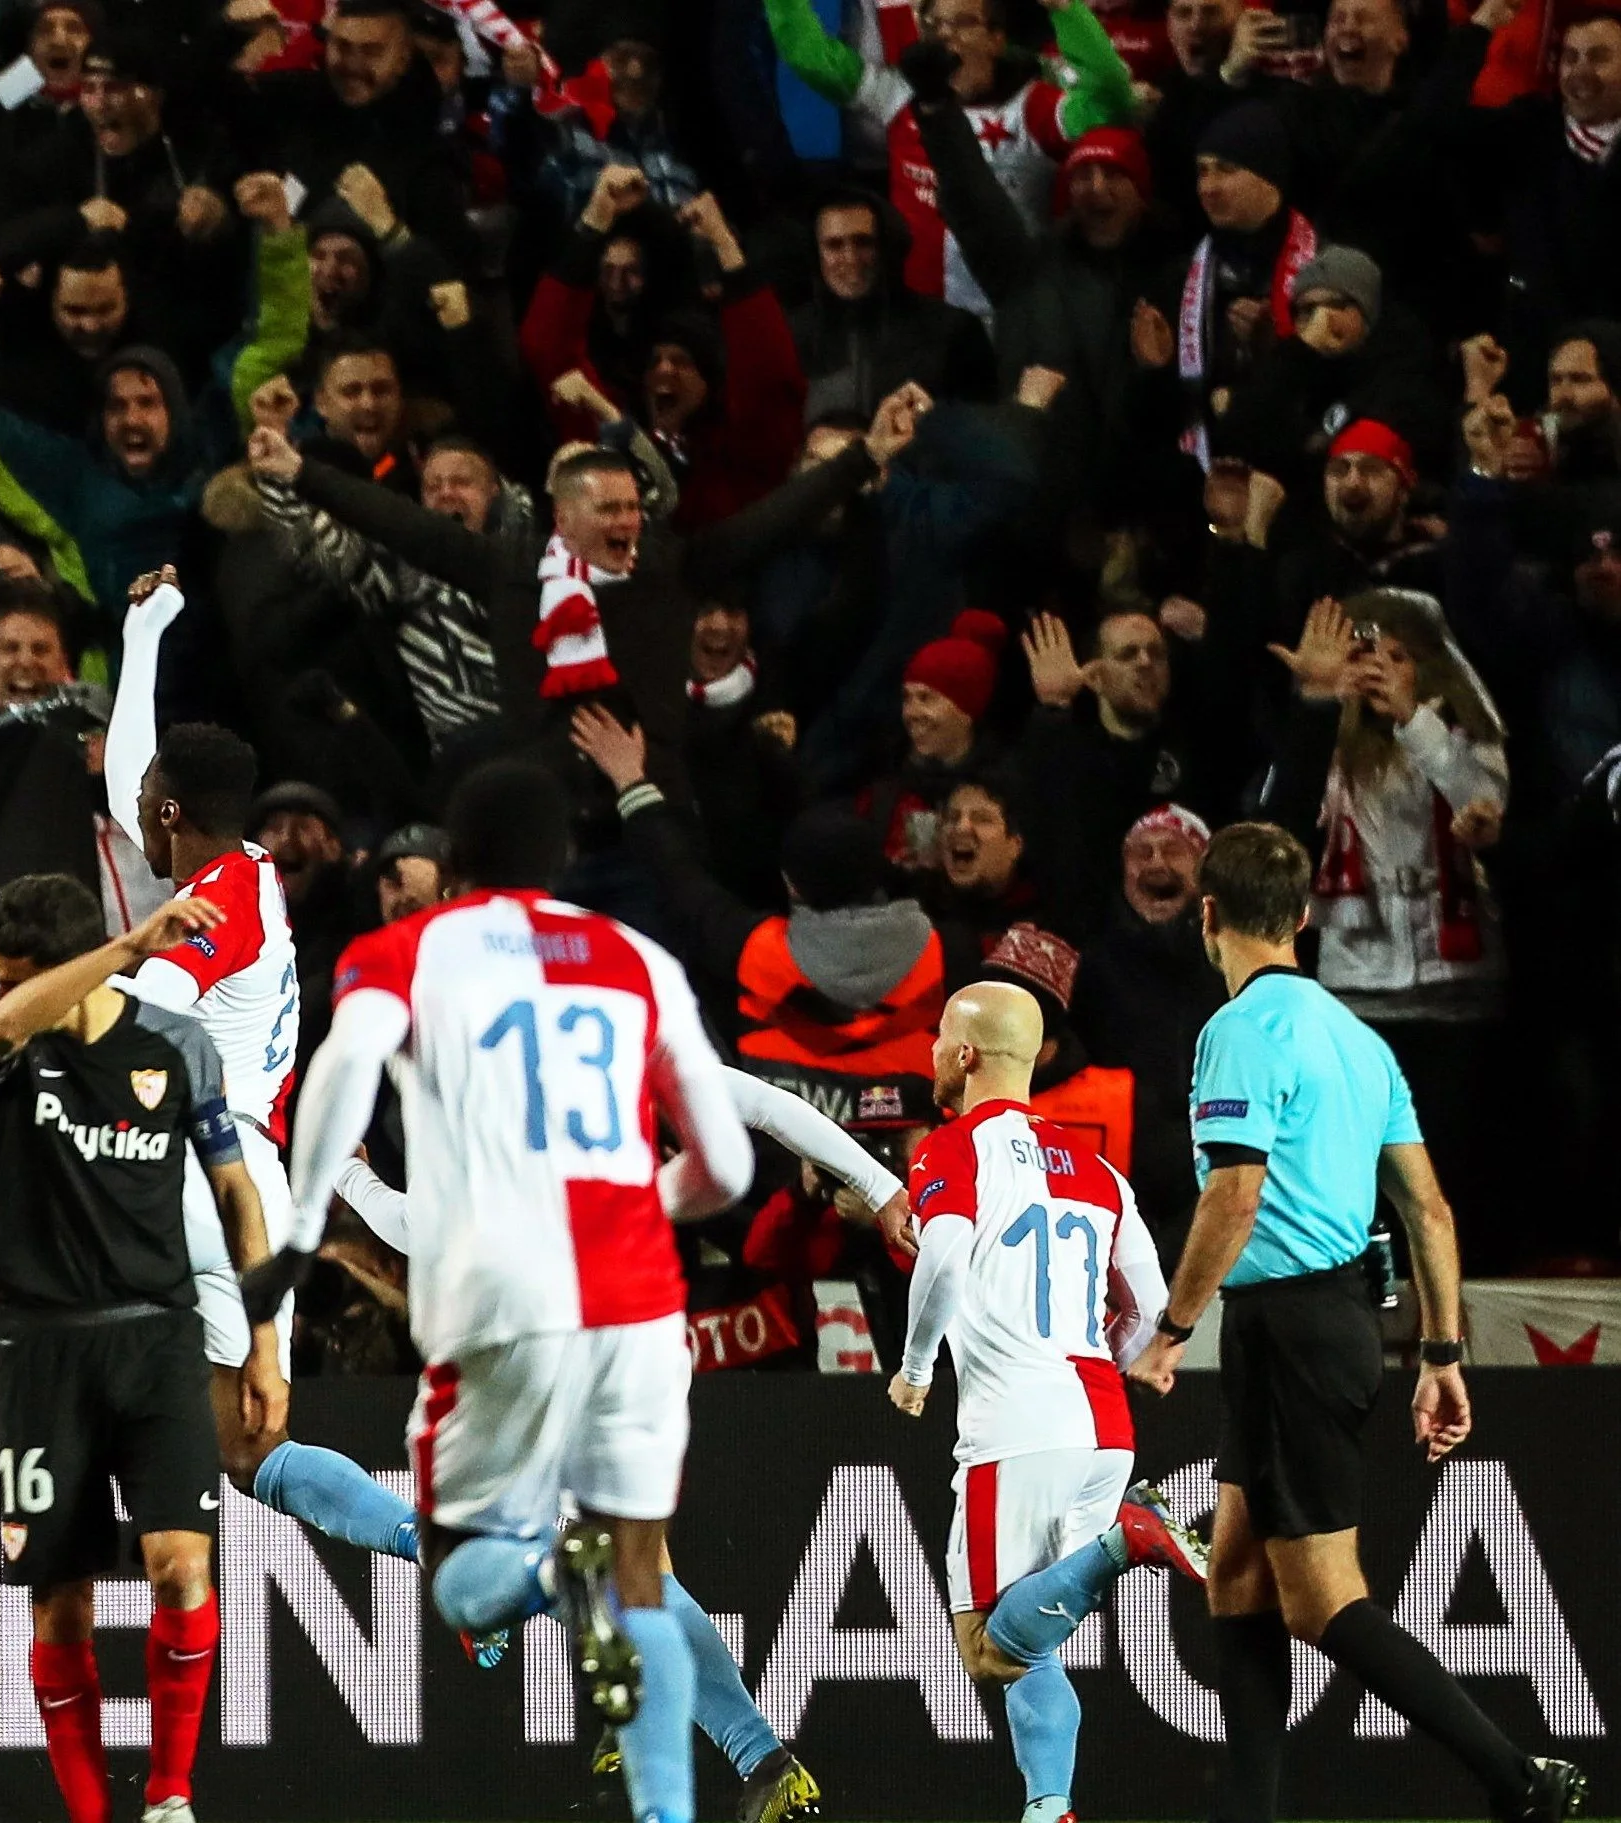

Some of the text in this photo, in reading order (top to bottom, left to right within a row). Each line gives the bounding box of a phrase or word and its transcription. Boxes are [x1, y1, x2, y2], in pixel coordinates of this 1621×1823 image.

[479, 1000, 623, 1152] 13
[1011, 1138, 1076, 1177] STOCH
[1000, 1203, 1100, 1348] 17
